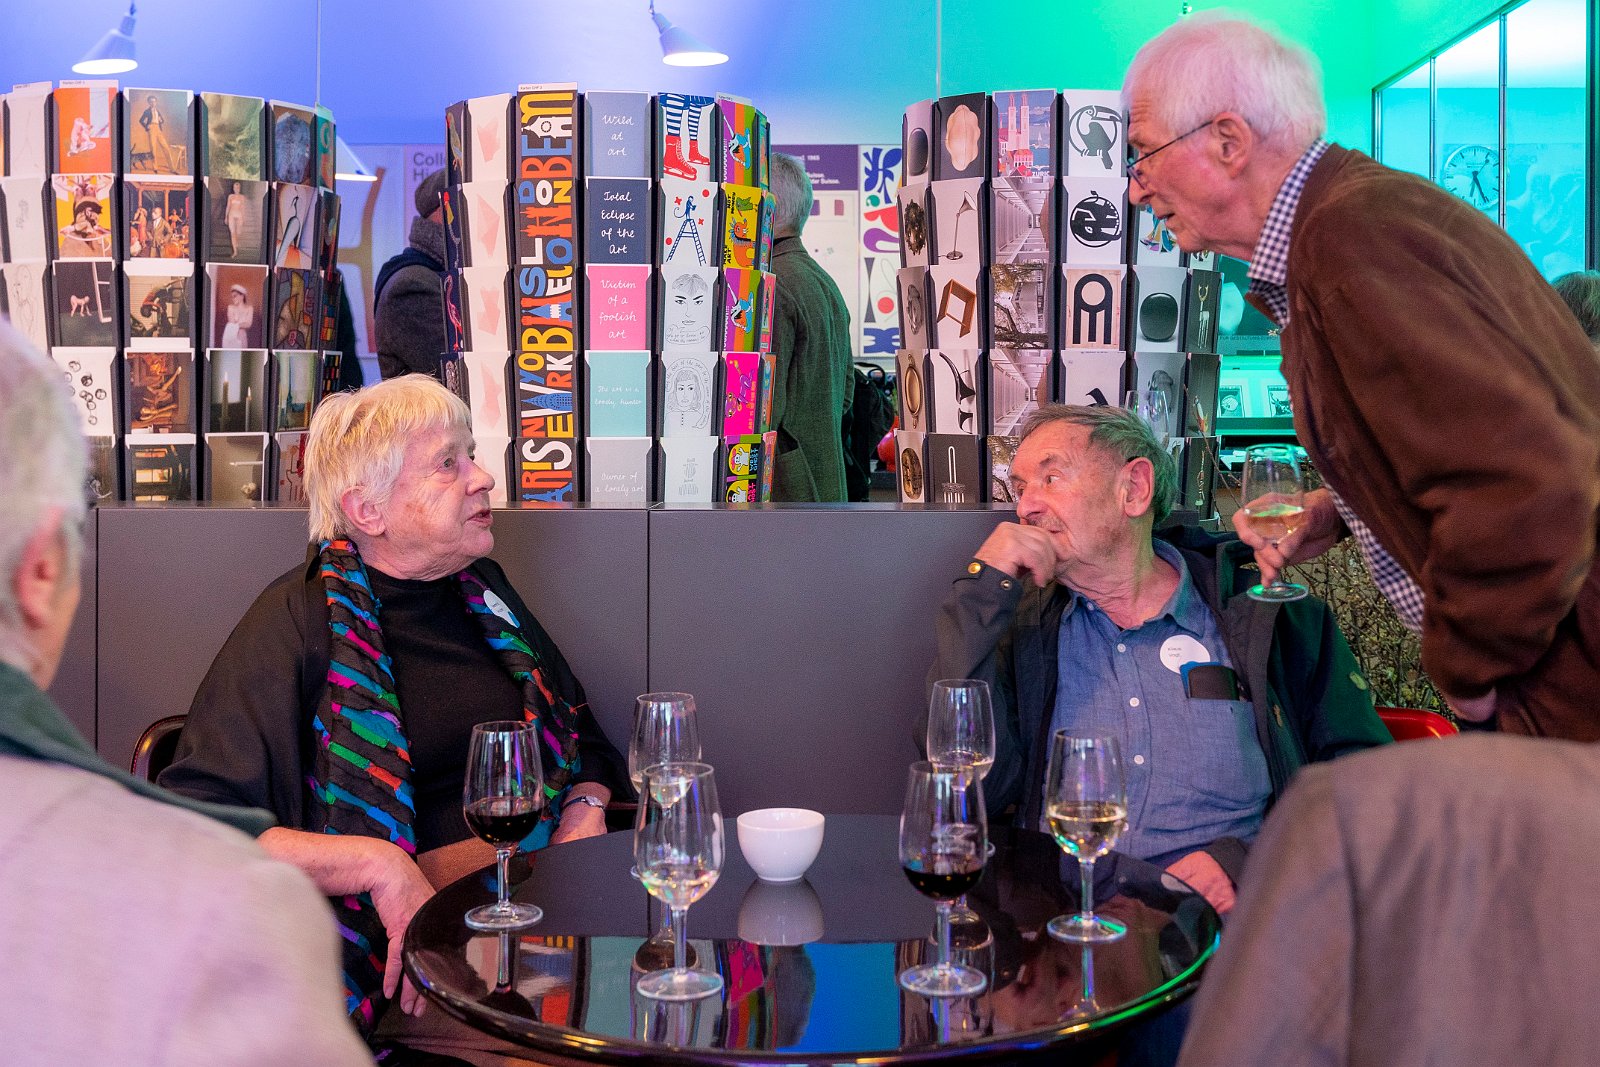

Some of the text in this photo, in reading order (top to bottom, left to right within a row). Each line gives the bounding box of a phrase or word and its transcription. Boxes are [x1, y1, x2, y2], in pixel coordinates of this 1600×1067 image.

[602, 114, 634, 126] Wild
[611, 132, 624, 140] at
[608, 147, 627, 156] art
[413, 151, 446, 166] Coll
[604, 192, 632, 202] Total
[601, 210, 635, 223] Eclipse
[601, 228, 635, 240] of the
[609, 244, 627, 254] Art
[601, 280, 636, 288] Victim
[608, 294, 618, 307] of
[519, 265, 574, 351] BASEL
[600, 311, 636, 325] foolish
[608, 330, 626, 338] art
[521, 439, 574, 503] ARIS
[601, 472, 637, 483] Owner of
[605, 484, 629, 496] lonely
